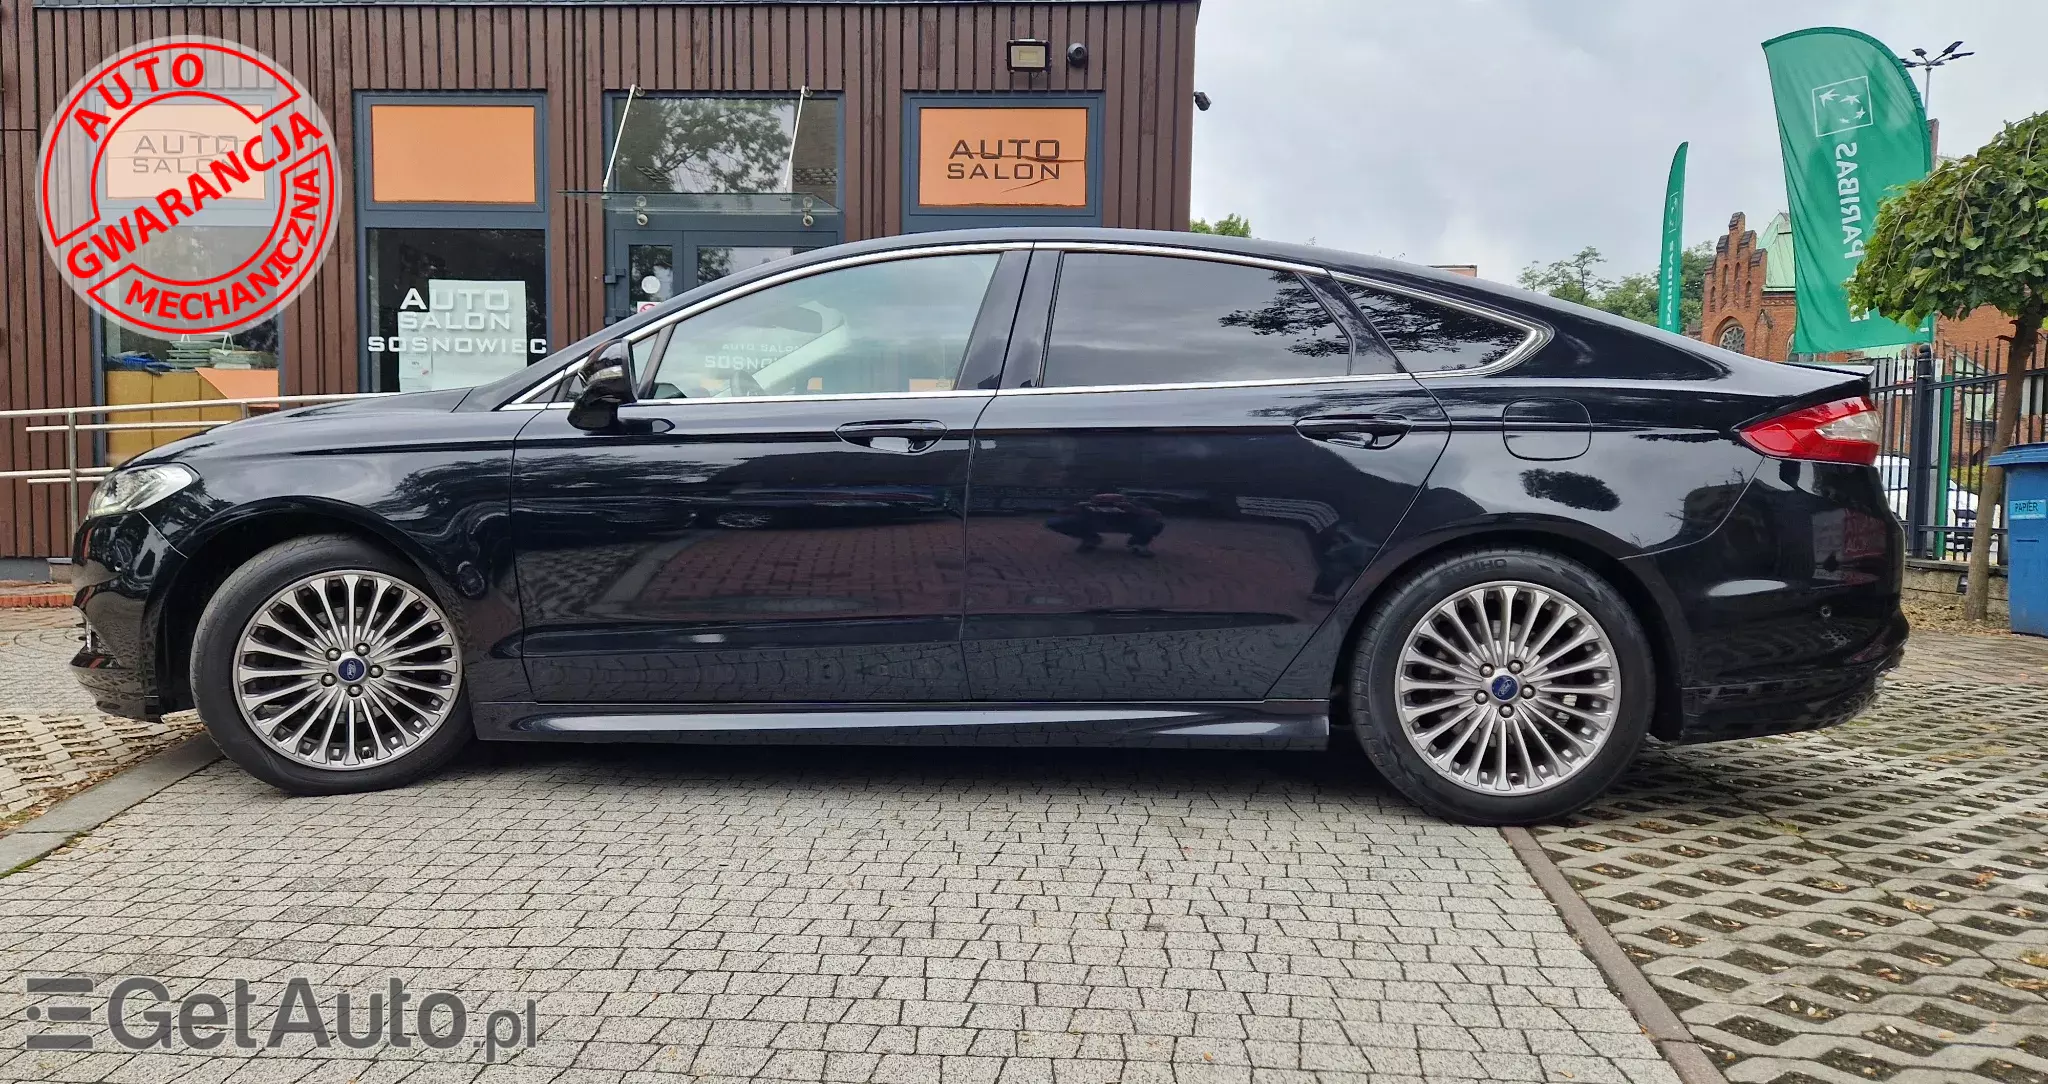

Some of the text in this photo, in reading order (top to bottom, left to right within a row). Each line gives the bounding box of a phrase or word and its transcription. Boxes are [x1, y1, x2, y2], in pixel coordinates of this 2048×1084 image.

[134, 135, 239, 154] AUTO
[948, 139, 1060, 160] AUTO
[947, 163, 1060, 180] SALON
[400, 287, 510, 311] AUTO
[399, 311, 511, 331] SALON
[367, 336, 547, 354] SOSNOWIEC
[722, 343, 756, 351] AUTO
[704, 356, 778, 369] SOSNO
[2014, 502, 2039, 512] PAPIER
